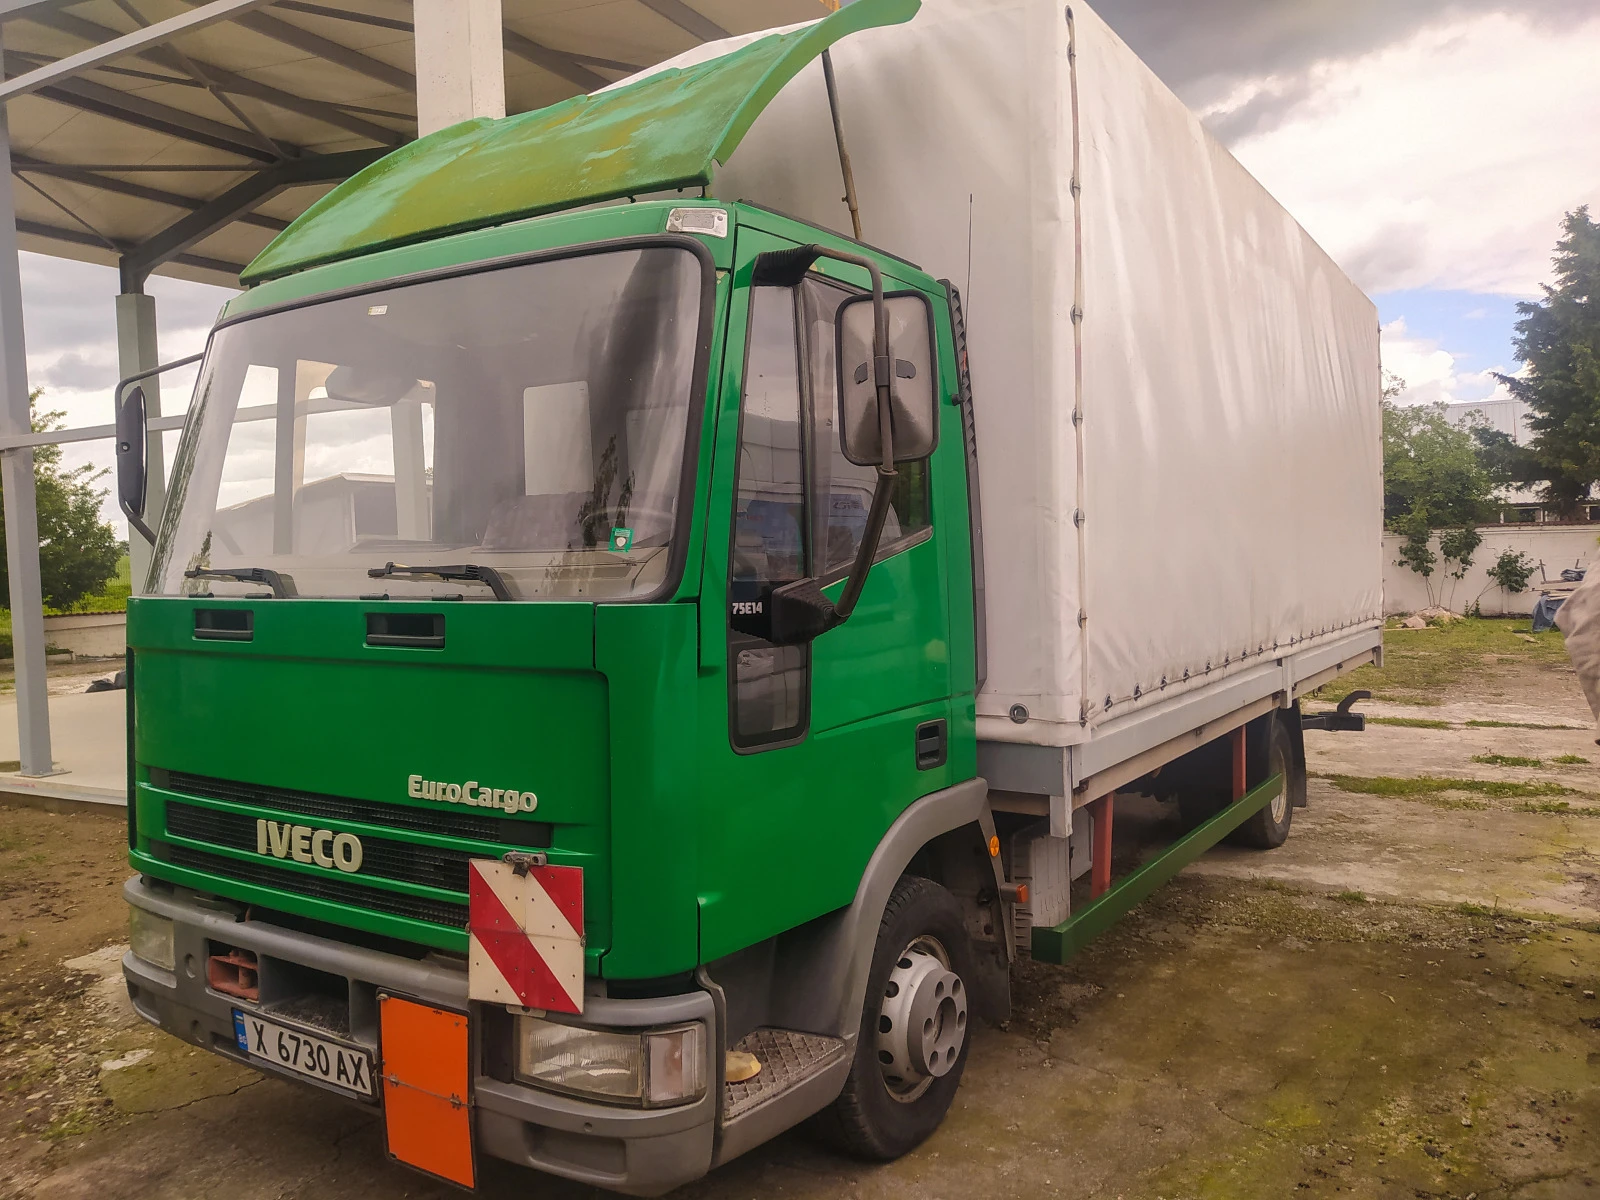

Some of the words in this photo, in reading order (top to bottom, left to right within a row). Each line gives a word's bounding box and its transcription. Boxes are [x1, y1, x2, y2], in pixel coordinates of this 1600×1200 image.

[732, 602, 763, 615] 75E14
[408, 774, 538, 814] EuroCargo
[256, 819, 363, 873] IVECO
[252, 1021, 268, 1055] X
[278, 1030, 330, 1076] 6730
[337, 1051, 367, 1090] AX
